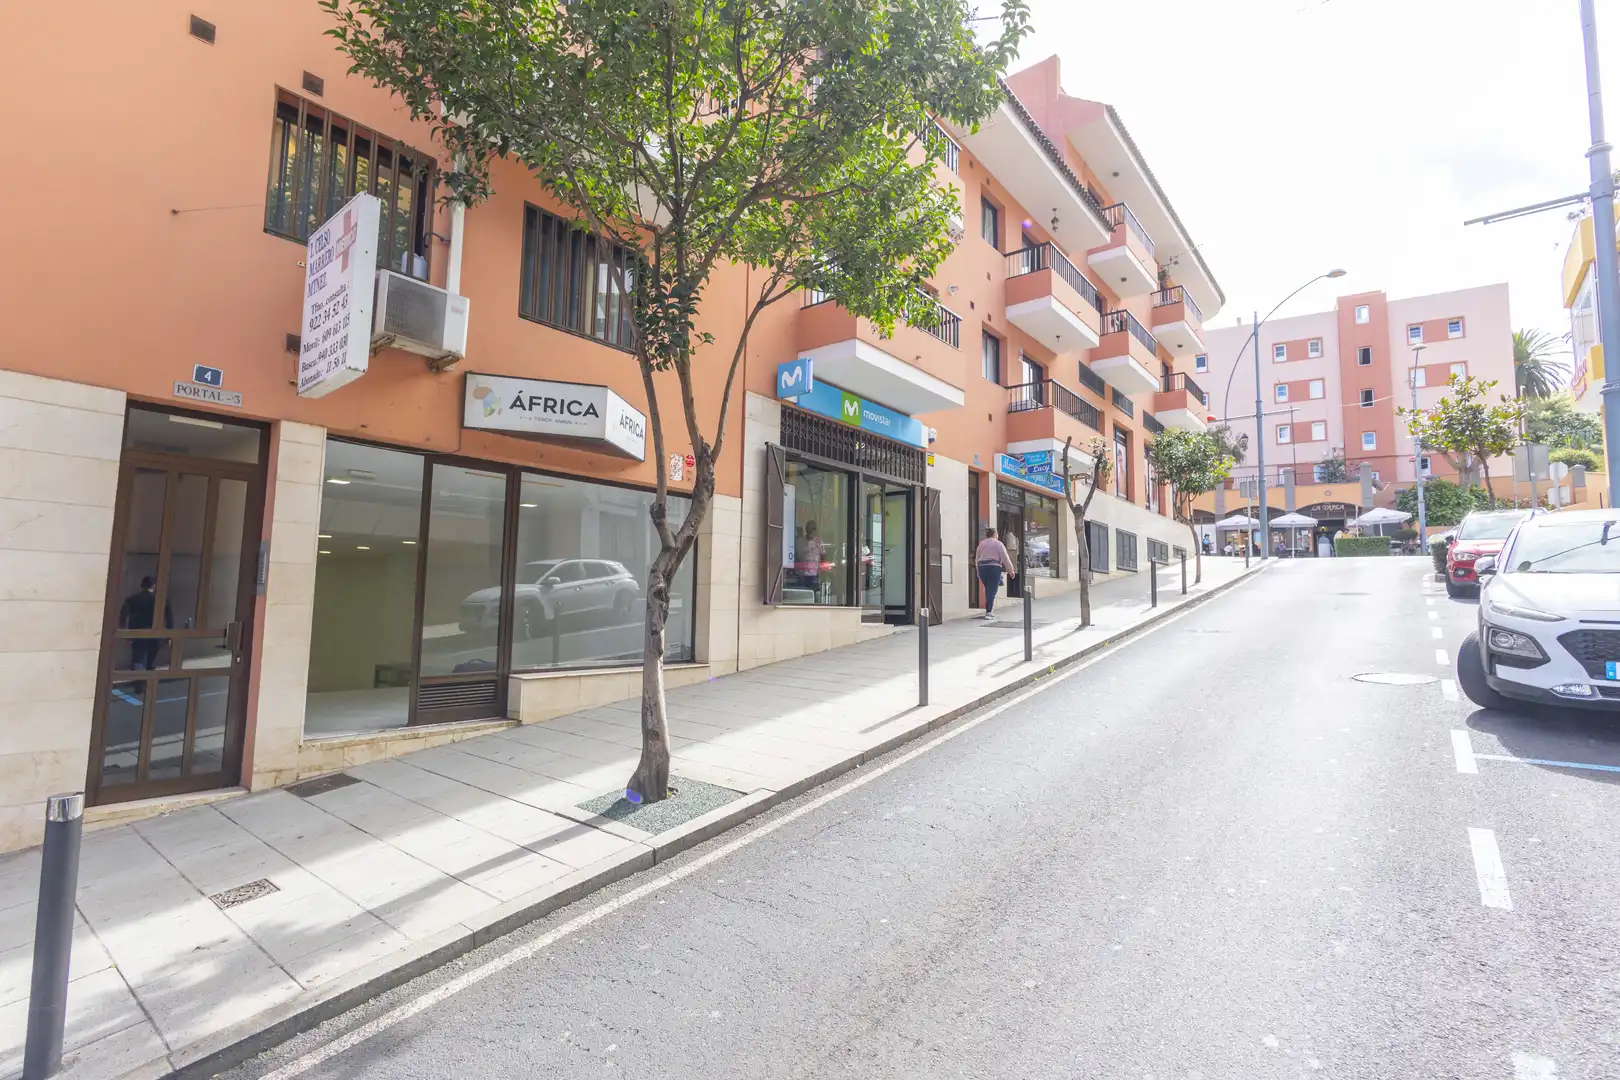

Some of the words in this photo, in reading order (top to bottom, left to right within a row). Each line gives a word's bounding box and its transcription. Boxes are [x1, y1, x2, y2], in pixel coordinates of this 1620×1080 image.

[315, 229, 331, 254] CELSO
[309, 246, 335, 278] MARRERO
[309, 314, 321, 332] 922
[322, 307, 331, 325] 34
[331, 300, 340, 318] 52
[321, 327, 332, 344] 609
[328, 340, 338, 358] 333
[204, 370, 212, 382] 4
[509, 390, 599, 418] ÁFRICA
[619, 409, 644, 440] ÁFRICA
[863, 409, 891, 427] movistar
